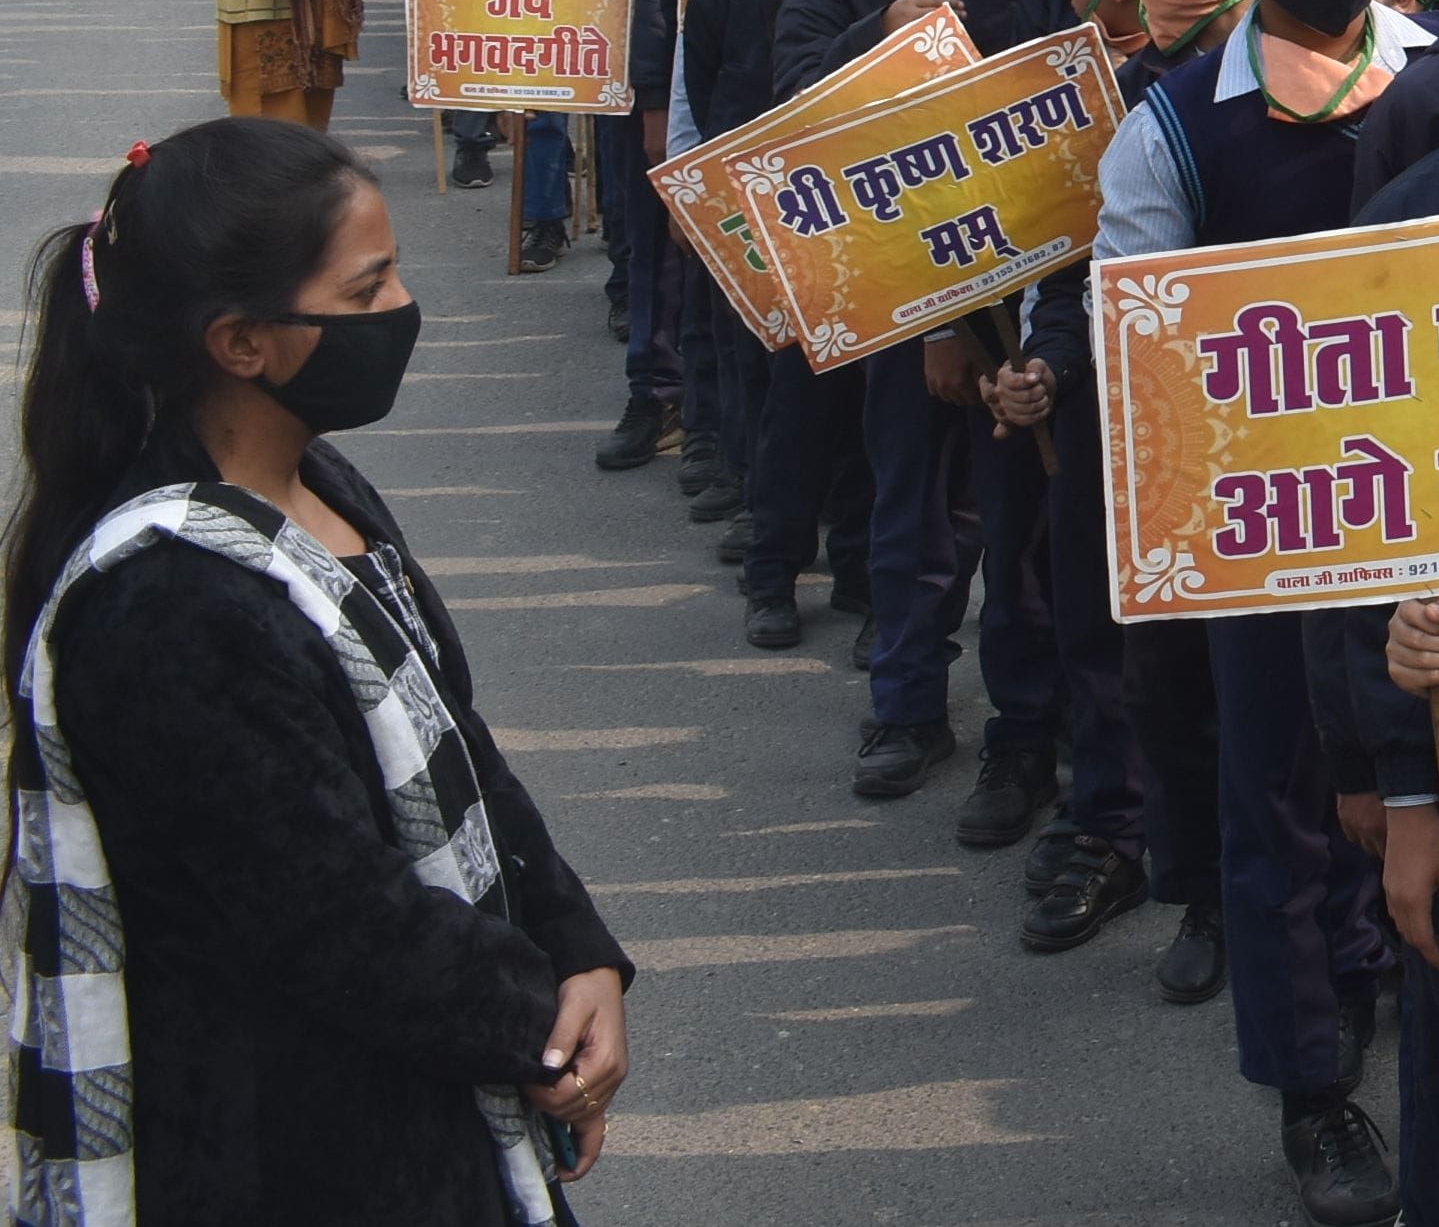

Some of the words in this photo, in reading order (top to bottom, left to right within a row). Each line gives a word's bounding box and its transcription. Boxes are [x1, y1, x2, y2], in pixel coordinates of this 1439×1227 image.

[429, 25, 612, 77] भगवदगीते
[774, 164, 850, 238] श्री
[842, 131, 973, 223] कृष्ण
[918, 203, 1026, 269] मम्
[1195, 300, 1418, 419] गीता
[1211, 434, 1418, 561] आगे
[1314, 570, 1334, 587] जी
[1336, 563, 1395, 585] ग्राफिक्स
